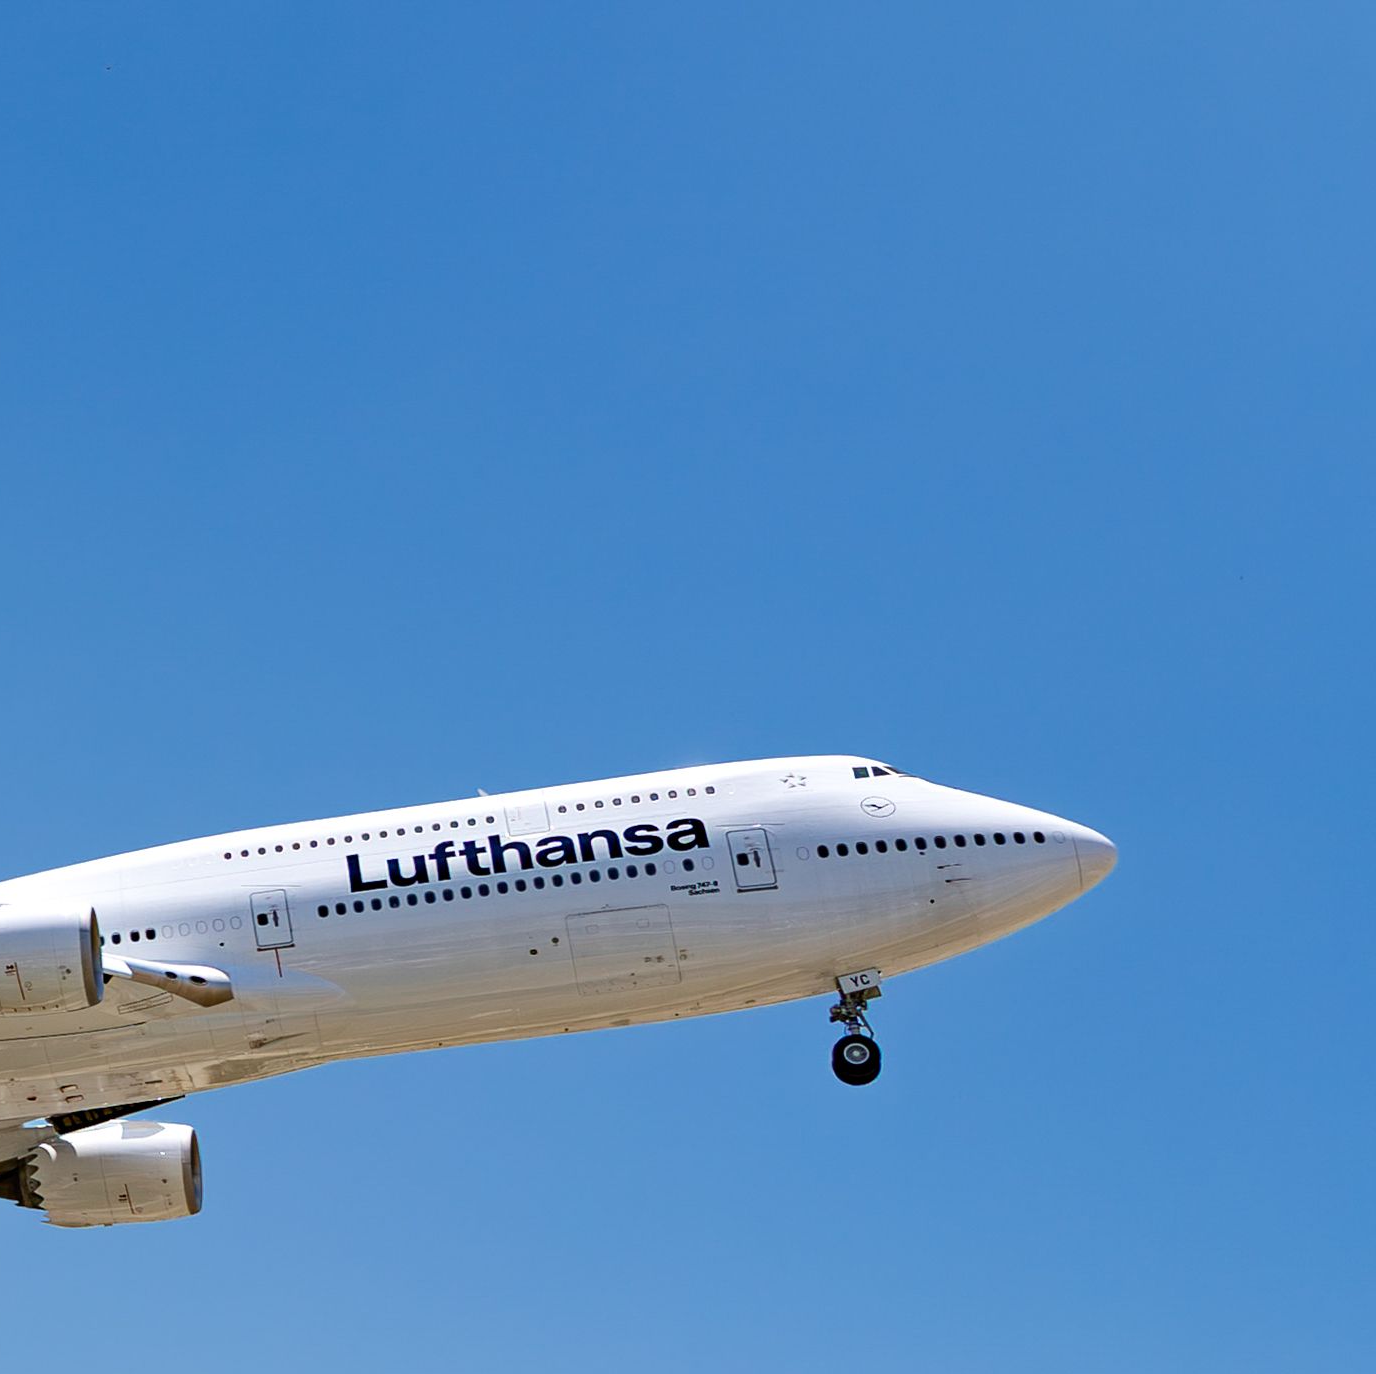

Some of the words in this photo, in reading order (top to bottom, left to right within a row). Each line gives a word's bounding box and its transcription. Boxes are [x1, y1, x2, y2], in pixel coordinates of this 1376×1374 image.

[345, 817, 711, 893] Lufthansa
[670, 884, 697, 892] Boeing
[688, 888, 720, 896] Sachsen
[849, 974, 870, 987] YC
